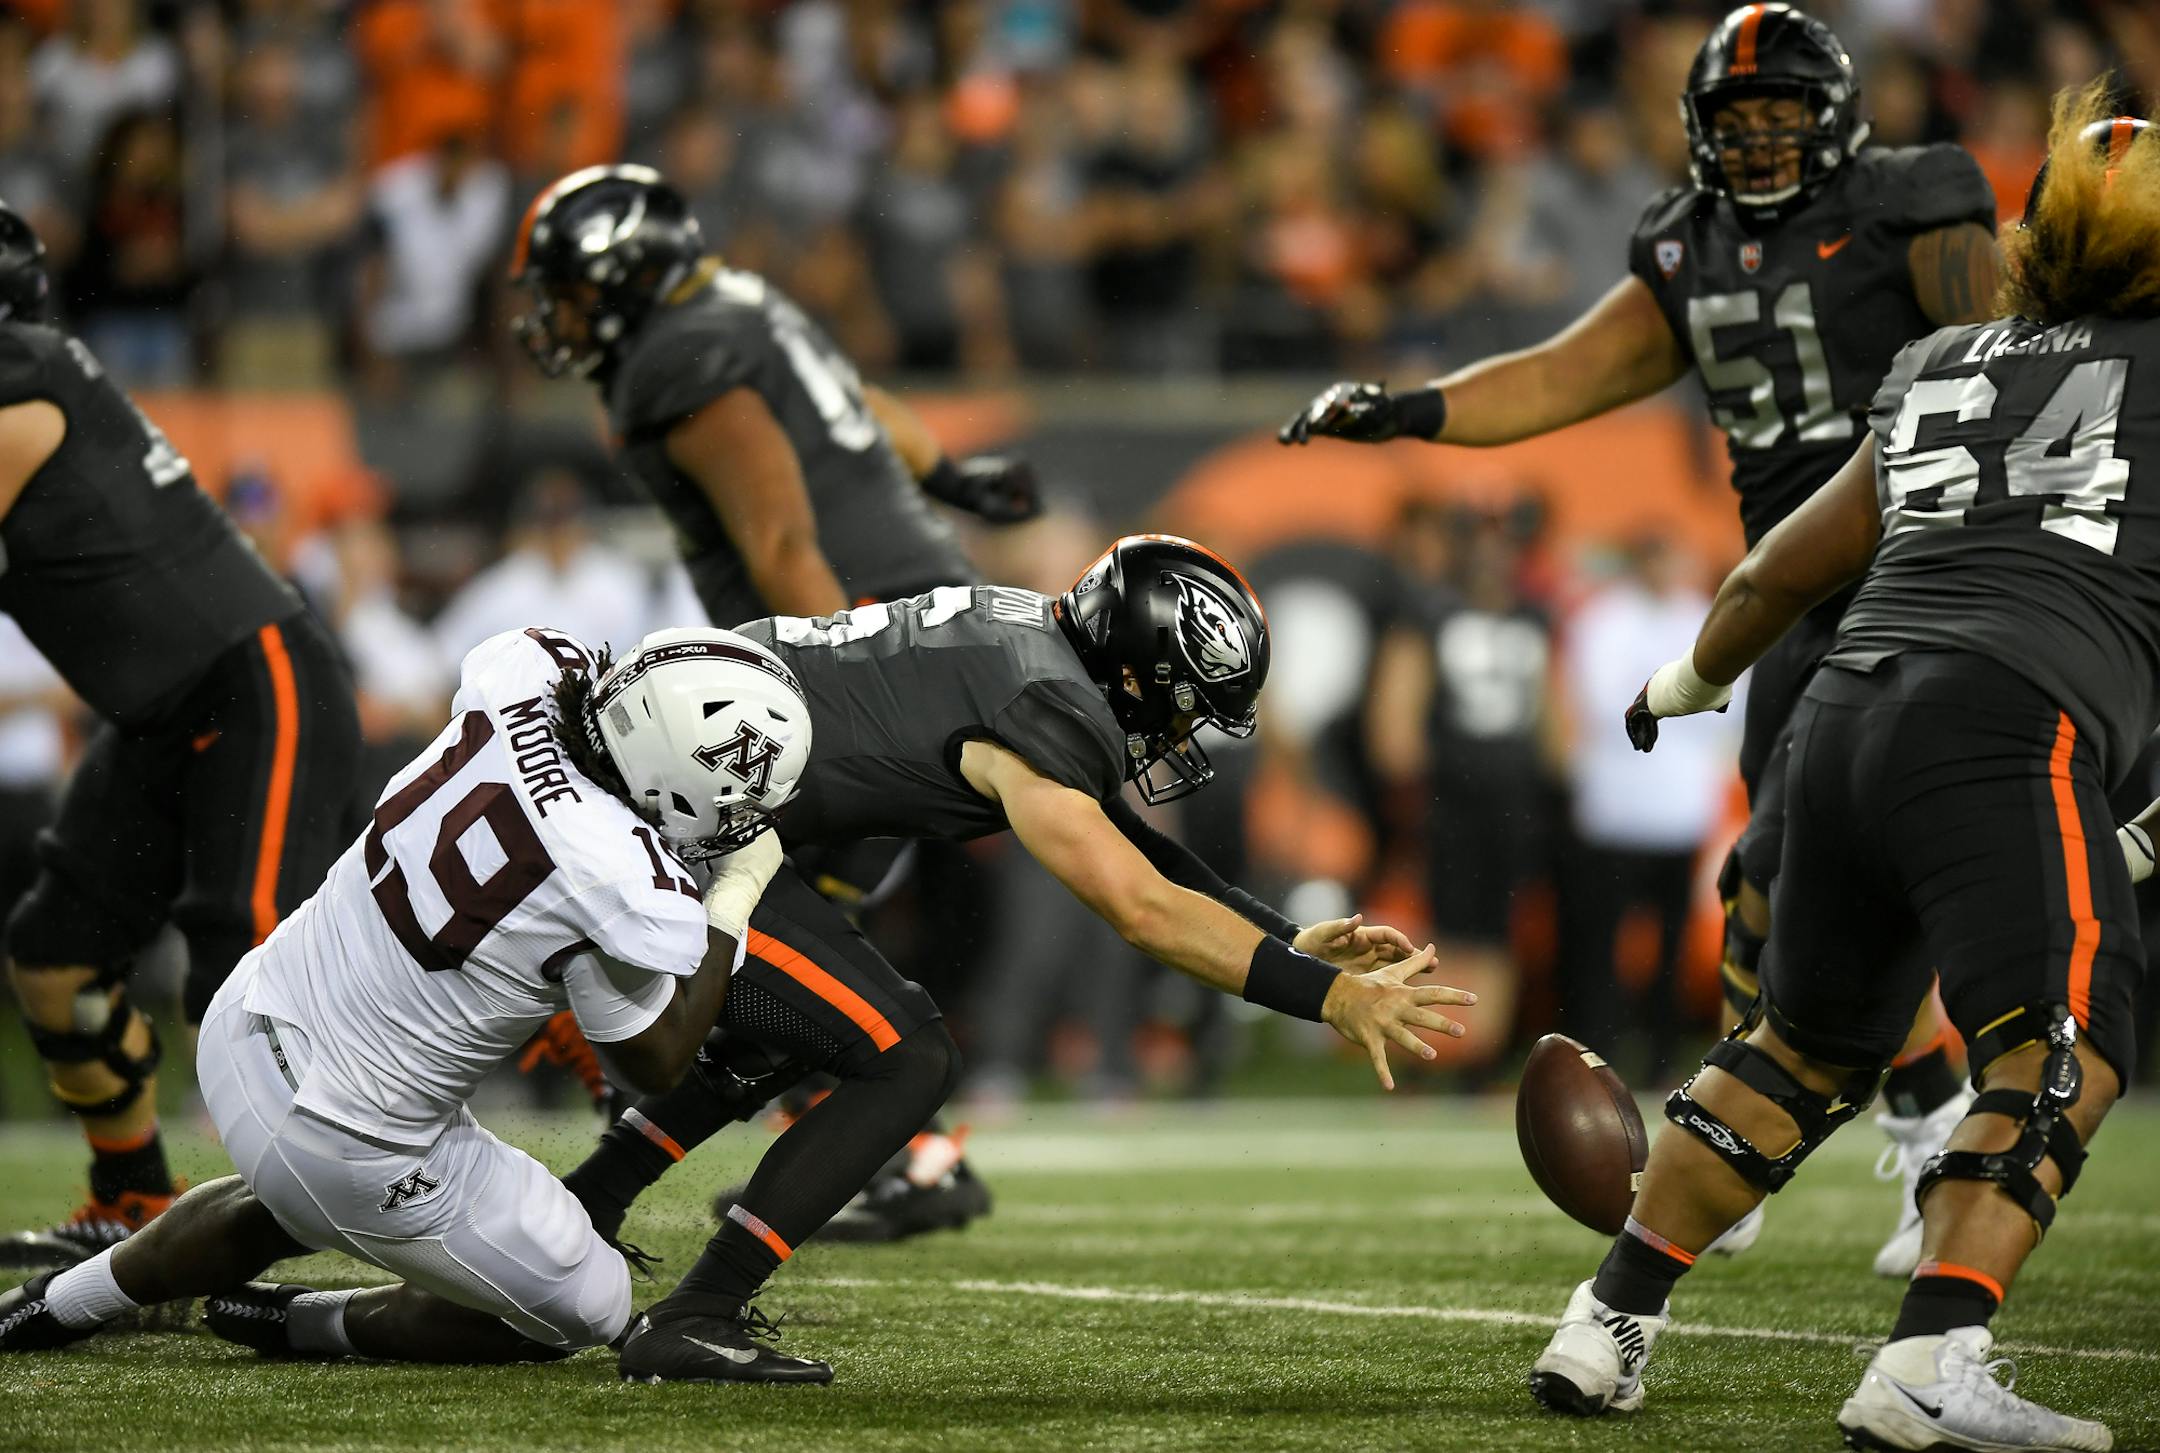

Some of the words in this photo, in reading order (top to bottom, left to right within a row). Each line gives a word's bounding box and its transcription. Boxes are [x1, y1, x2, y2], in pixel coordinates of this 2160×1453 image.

[1687, 281, 1854, 448] 51
[1881, 359, 2131, 557] 64
[498, 695, 583, 819] MOORE
[690, 719, 784, 801] M
[364, 709, 558, 972] 19
[1688, 1114, 1748, 1156] DONJOY
